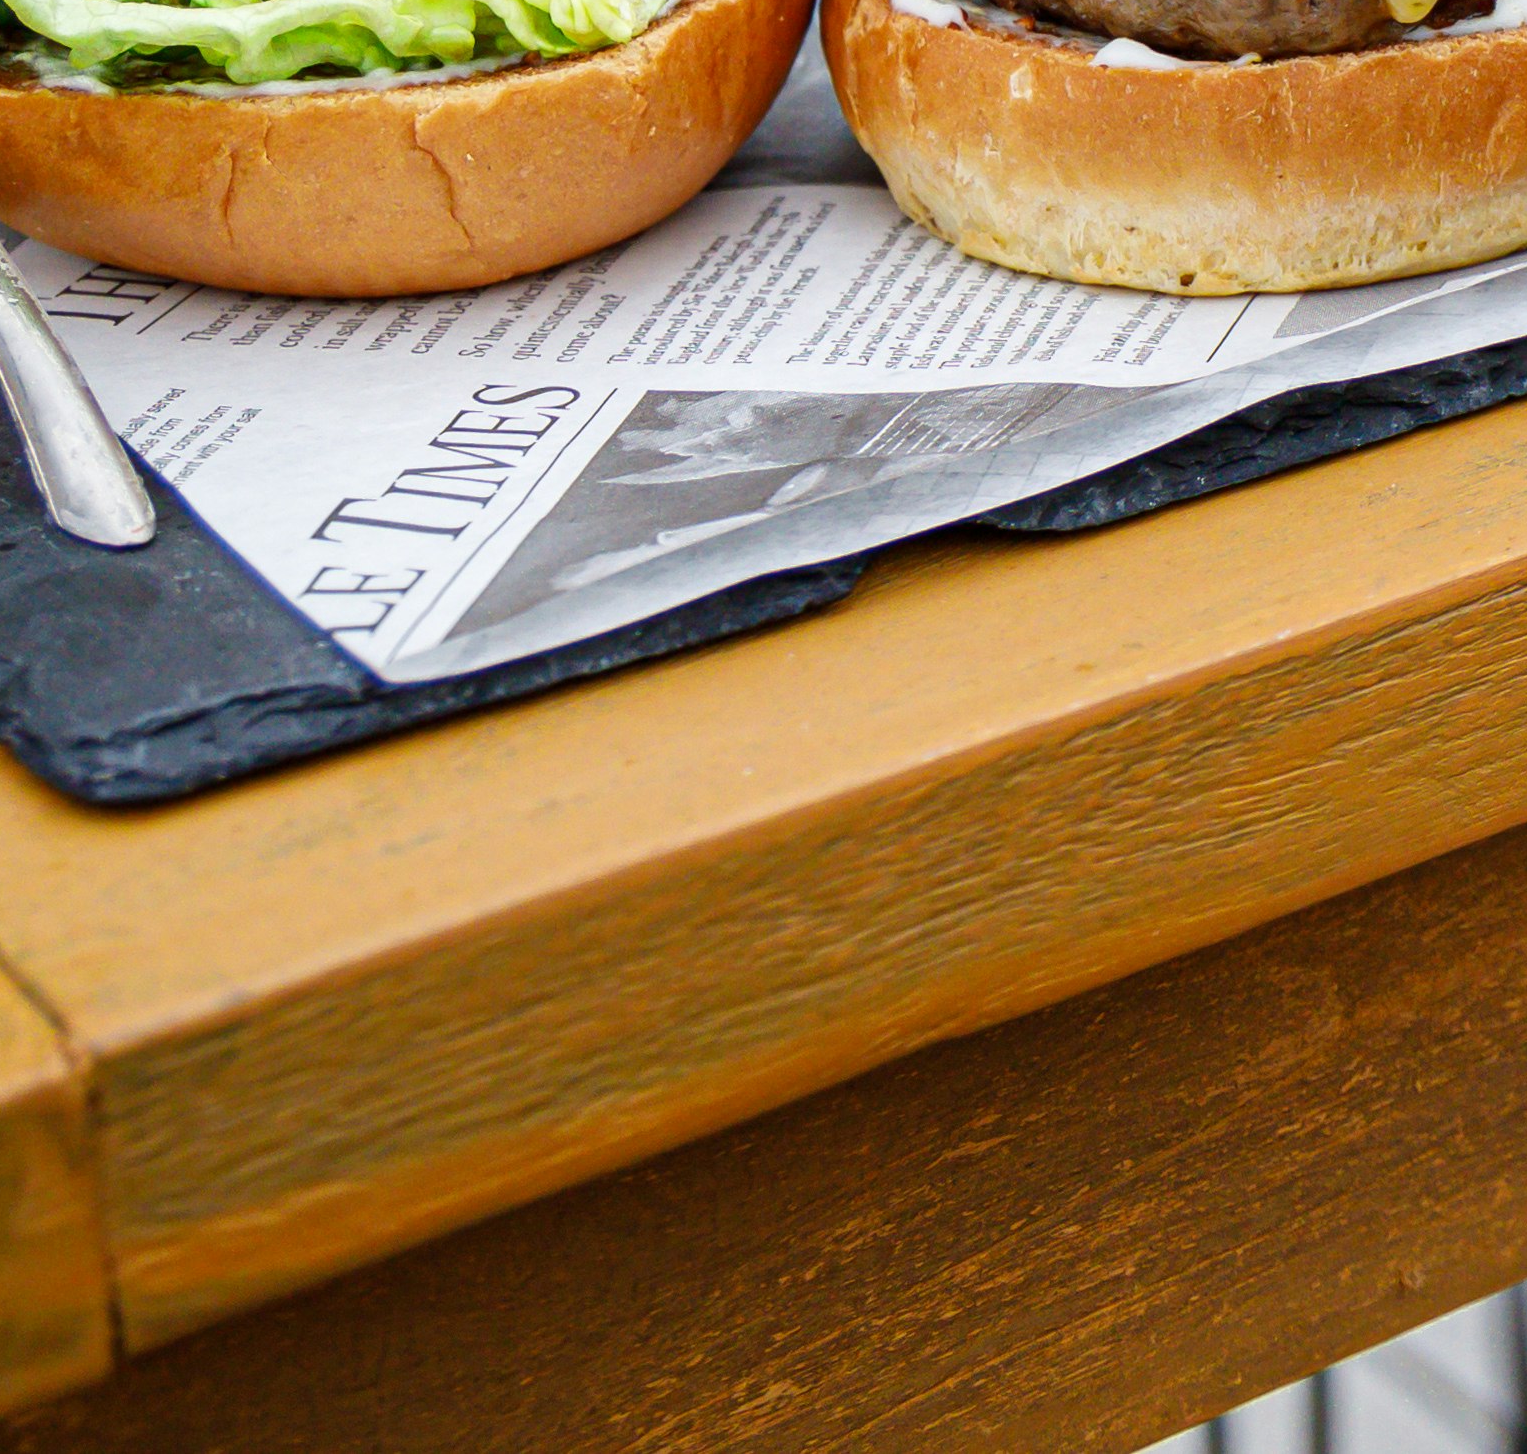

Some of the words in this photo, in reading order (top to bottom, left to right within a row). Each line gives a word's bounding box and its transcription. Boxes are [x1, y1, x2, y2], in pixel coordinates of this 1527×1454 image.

[505, 283, 548, 313] when
[511, 277, 606, 361] quintessentially
[785, 347, 815, 365] The
[864, 248, 892, 263] fish
[846, 321, 895, 367] Lancashire
[889, 276, 931, 307] London
[180, 313, 240, 342] There
[228, 322, 274, 346] than
[254, 304, 297, 322] fish
[335, 317, 368, 337] salt
[363, 305, 424, 352] wrapped
[410, 316, 459, 355] cannot
[436, 300, 473, 315] be
[472, 314, 523, 342] how,
[555, 330, 596, 363] come
[577, 293, 627, 330] about?
[605, 346, 637, 365] The
[627, 317, 658, 346] potato
[636, 317, 689, 366] introduced
[666, 330, 711, 365] England
[694, 309, 726, 330] from
[821, 330, 859, 365] together
[894, 322, 926, 341] food
[908, 353, 937, 370] fish
[936, 292, 978, 335] introduced
[937, 353, 967, 370] The
[956, 314, 993, 353] populace
[982, 295, 1006, 314] soon
[969, 354, 999, 369] fish
[1010, 284, 1045, 317] together
[1048, 325, 1077, 341] fish
[457, 342, 494, 358] So
[732, 338, 763, 365] potato
[884, 342, 912, 370] staple
[121, 408, 159, 443] sually
[146, 387, 187, 414] served
[148, 417, 183, 437] from
[153, 449, 181, 473] ally
[170, 424, 211, 452] comes
[197, 405, 233, 424] from
[136, 435, 161, 457] ade
[174, 460, 203, 490] ment
[193, 442, 223, 460] with
[213, 423, 244, 444] your
[235, 407, 263, 424] salt
[309, 383, 581, 541] TIMES
